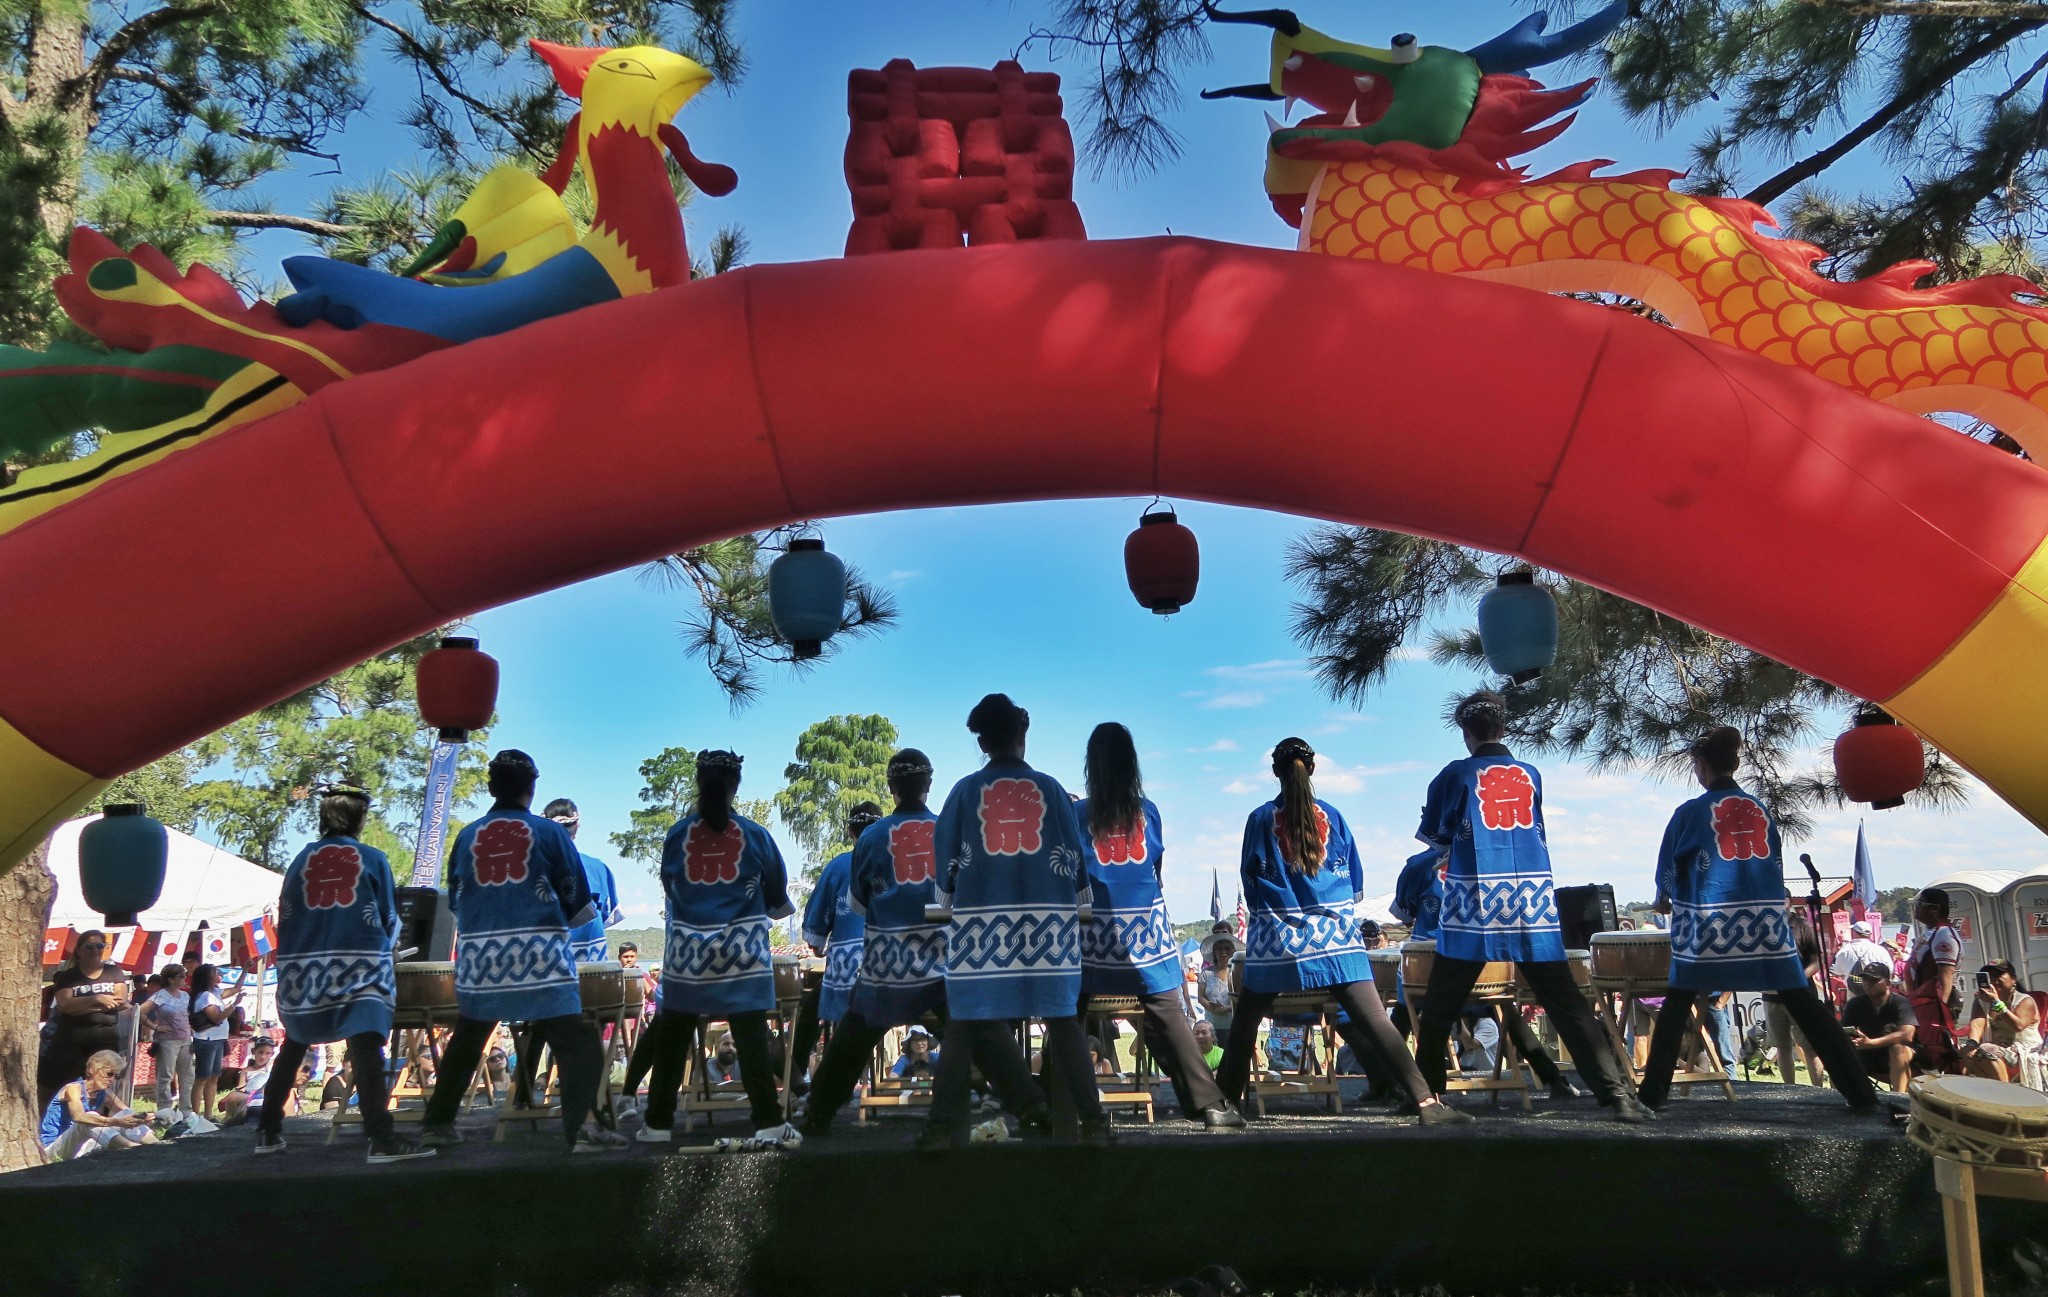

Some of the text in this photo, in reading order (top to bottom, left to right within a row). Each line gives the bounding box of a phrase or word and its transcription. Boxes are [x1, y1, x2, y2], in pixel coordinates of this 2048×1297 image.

[978, 778, 1046, 855] 祭
[1476, 765, 1535, 829] 祭
[1711, 796, 1769, 860] 祭
[419, 773, 449, 887] TERTAINMENT
[471, 819, 532, 885] 祭
[303, 845, 362, 909] 祭
